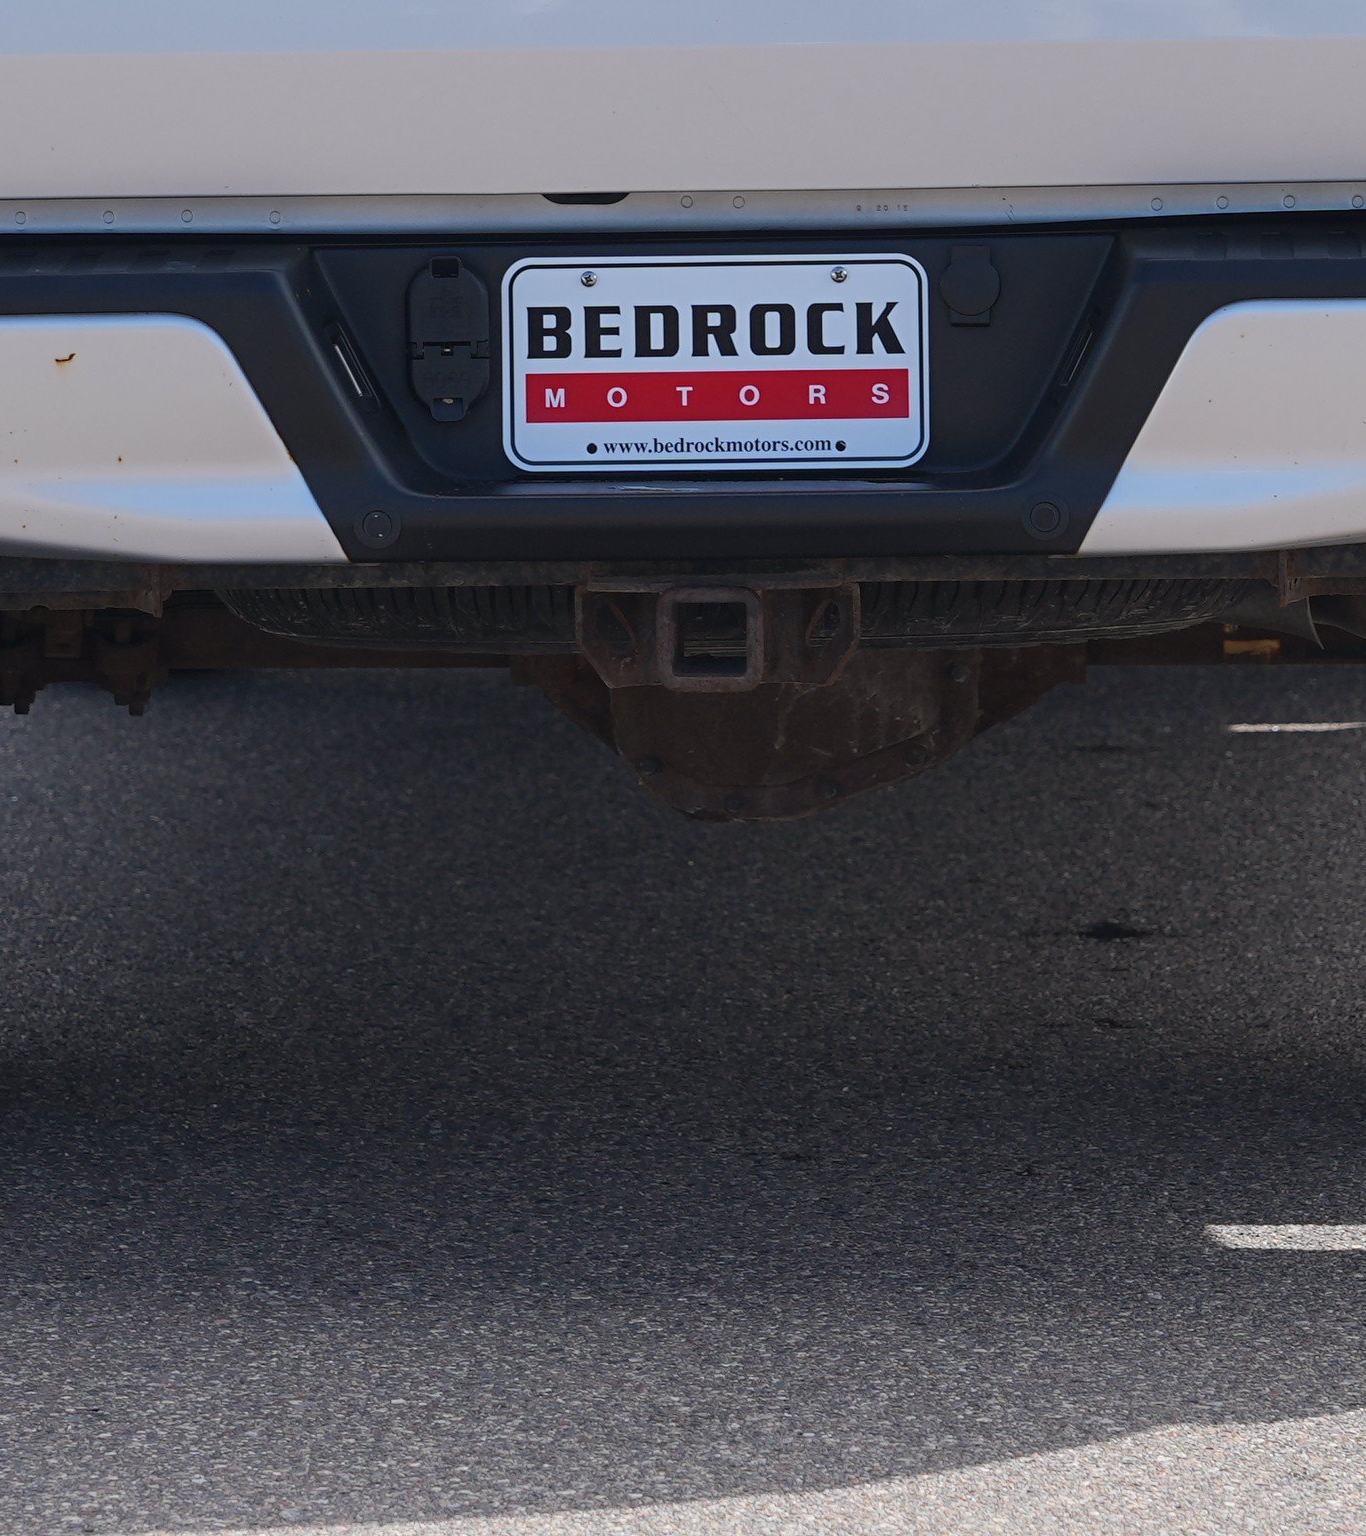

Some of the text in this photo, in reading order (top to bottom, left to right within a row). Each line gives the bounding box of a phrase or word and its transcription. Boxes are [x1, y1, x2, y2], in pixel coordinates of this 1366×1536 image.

[526, 302, 906, 360] BEDROCK
[544, 383, 891, 409] MOTORS
[603, 437, 832, 455] www.bedrockmotors.com
